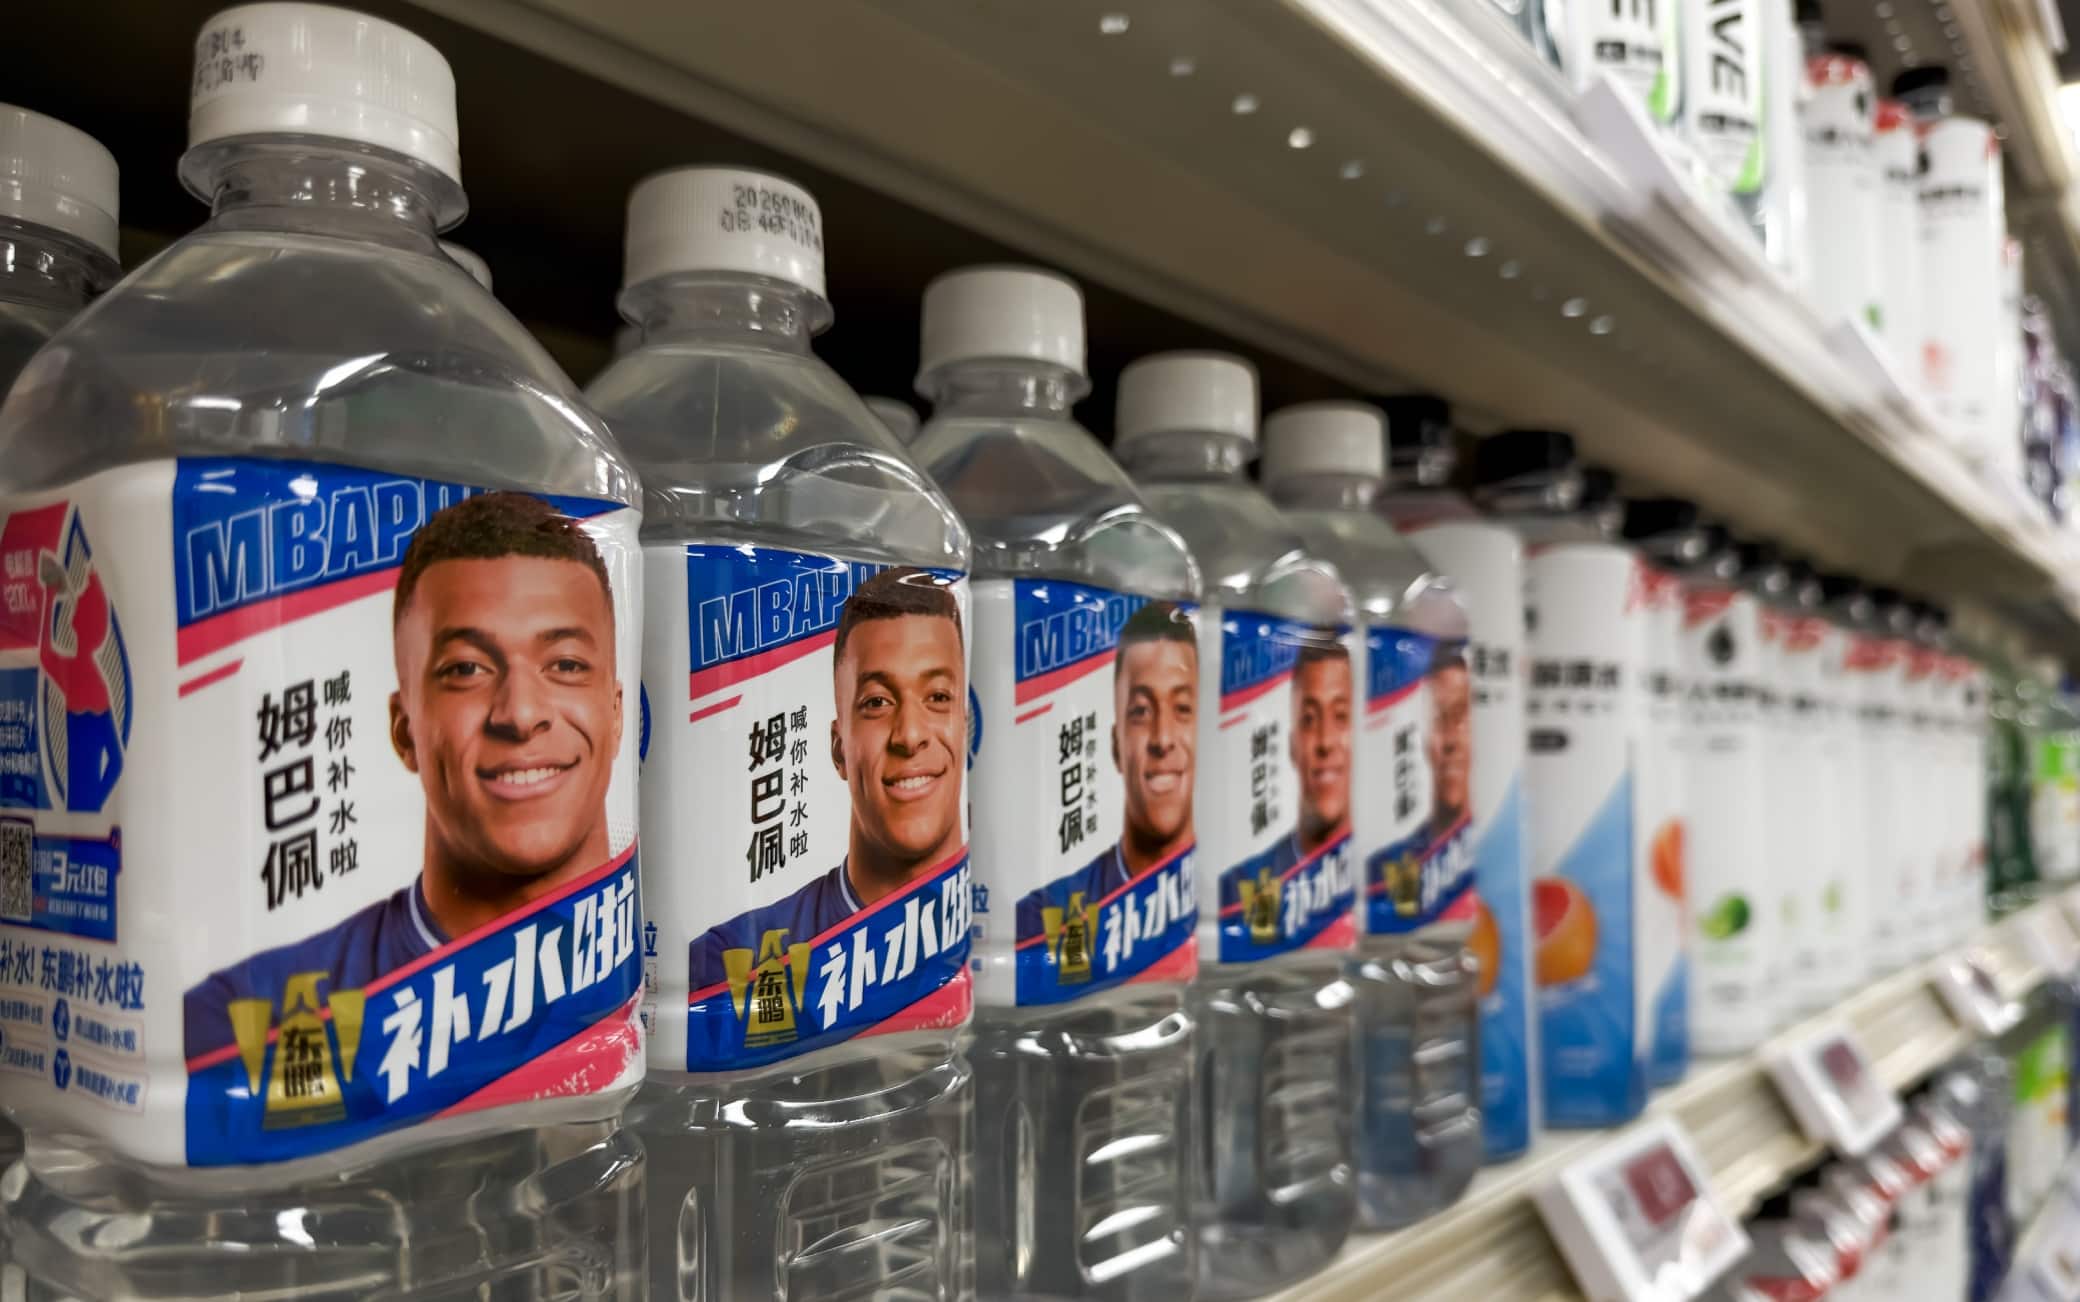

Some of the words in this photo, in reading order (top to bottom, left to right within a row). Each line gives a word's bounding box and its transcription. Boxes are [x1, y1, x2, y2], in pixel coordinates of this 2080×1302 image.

[1708, 0, 1748, 104] VE
[187, 478, 497, 619] MBAP
[700, 561, 894, 666] MBAP
[1023, 594, 1150, 678] MBAP
[257, 679, 323, 911] 姆巴佩
[323, 670, 360, 878] 喊你补水啦
[746, 712, 787, 883] 姆巴佩
[790, 705, 808, 859] 喊你补水啦
[1059, 714, 1084, 854] 姆巴佩
[377, 871, 635, 1104] 补水啦
[758, 969, 785, 1024] 东鹏
[817, 860, 972, 1030] 补水啦
